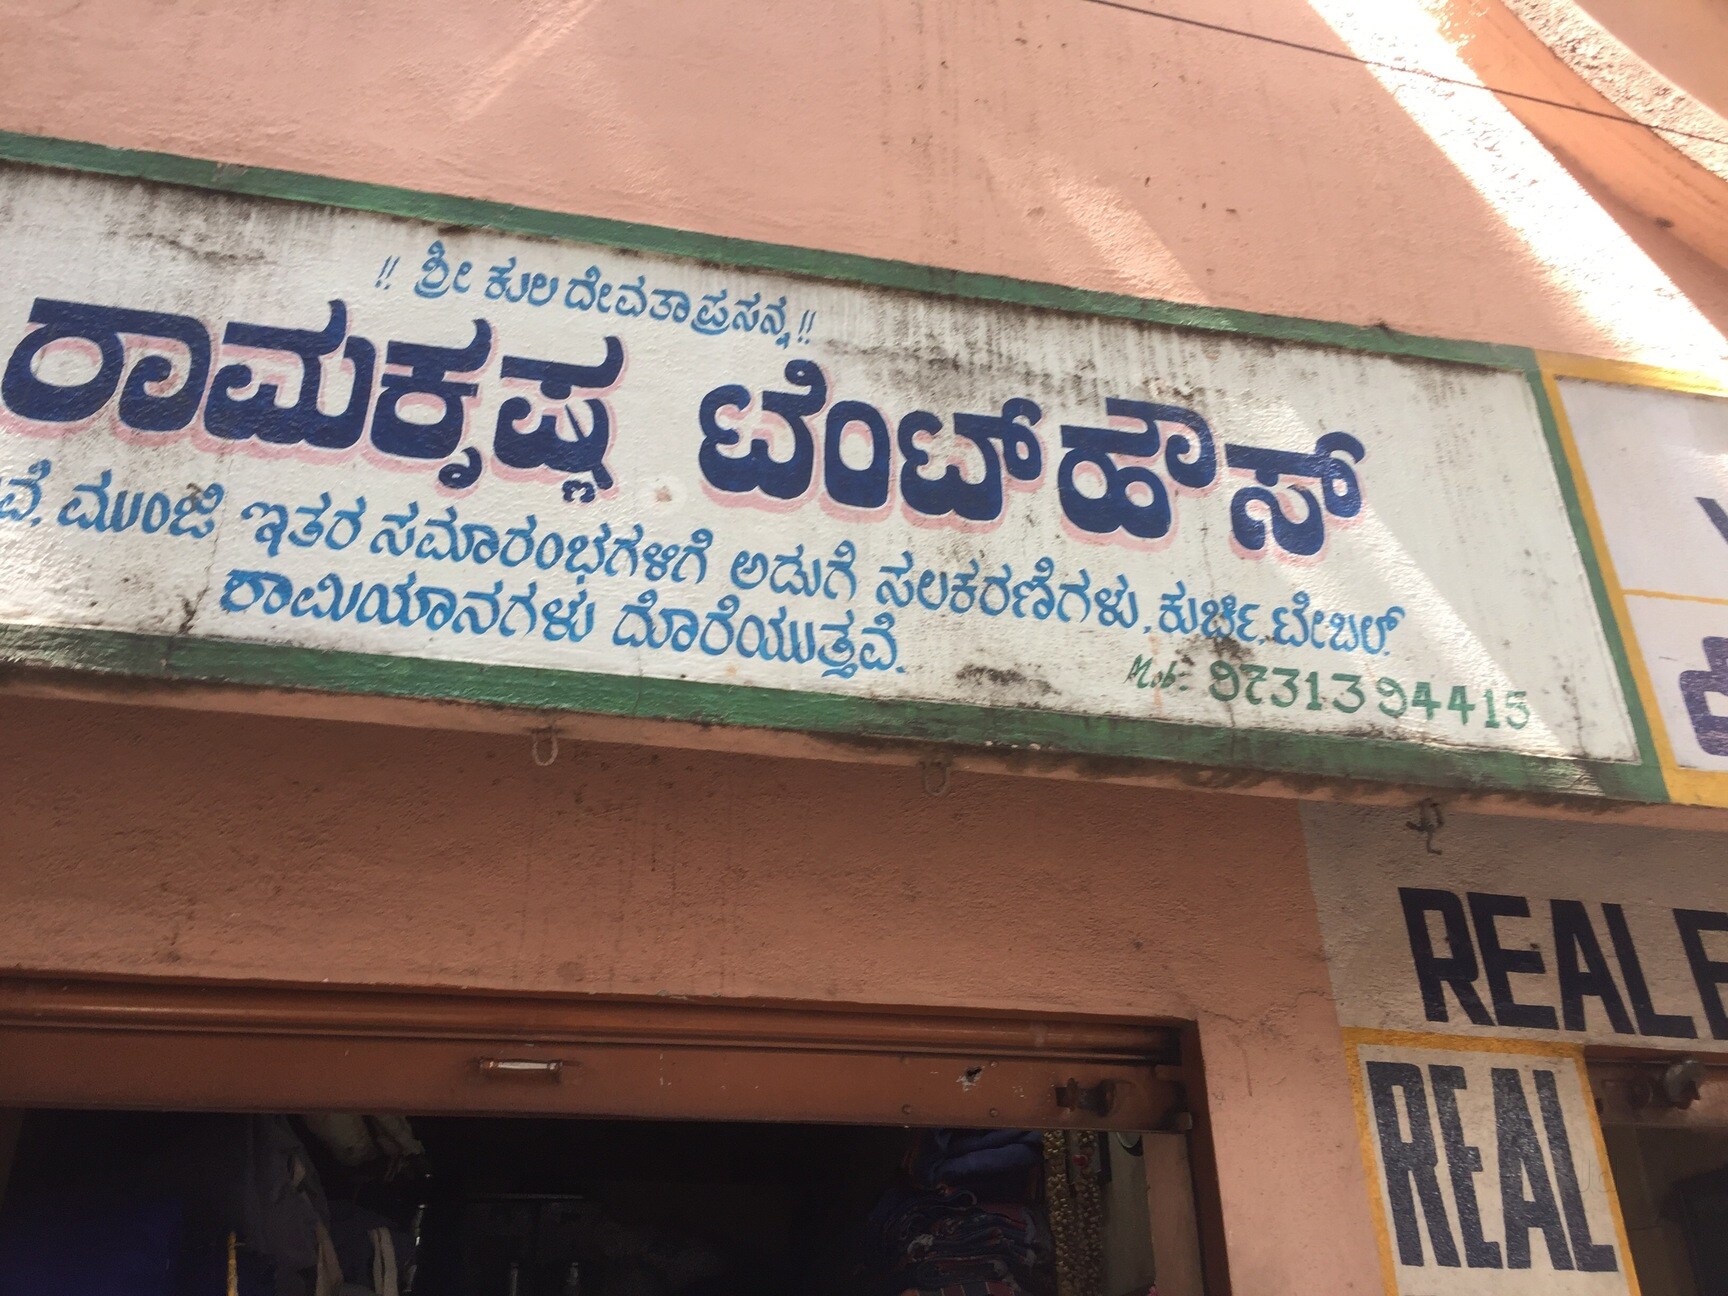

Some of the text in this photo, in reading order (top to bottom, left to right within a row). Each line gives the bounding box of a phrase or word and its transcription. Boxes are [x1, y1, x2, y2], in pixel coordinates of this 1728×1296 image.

[413, 240, 474, 299] ಶ್ರೀ
[0, 296, 627, 505] ರಾಮಕೃಷ್ಣ
[241, 491, 367, 558] ಇತರ
[369, 501, 714, 586] ಸಮಾರಂಭಗಳಿಗೆ
[729, 539, 858, 602] ಅಡುಗೆ
[1366, 1060, 1619, 1274] REAL
